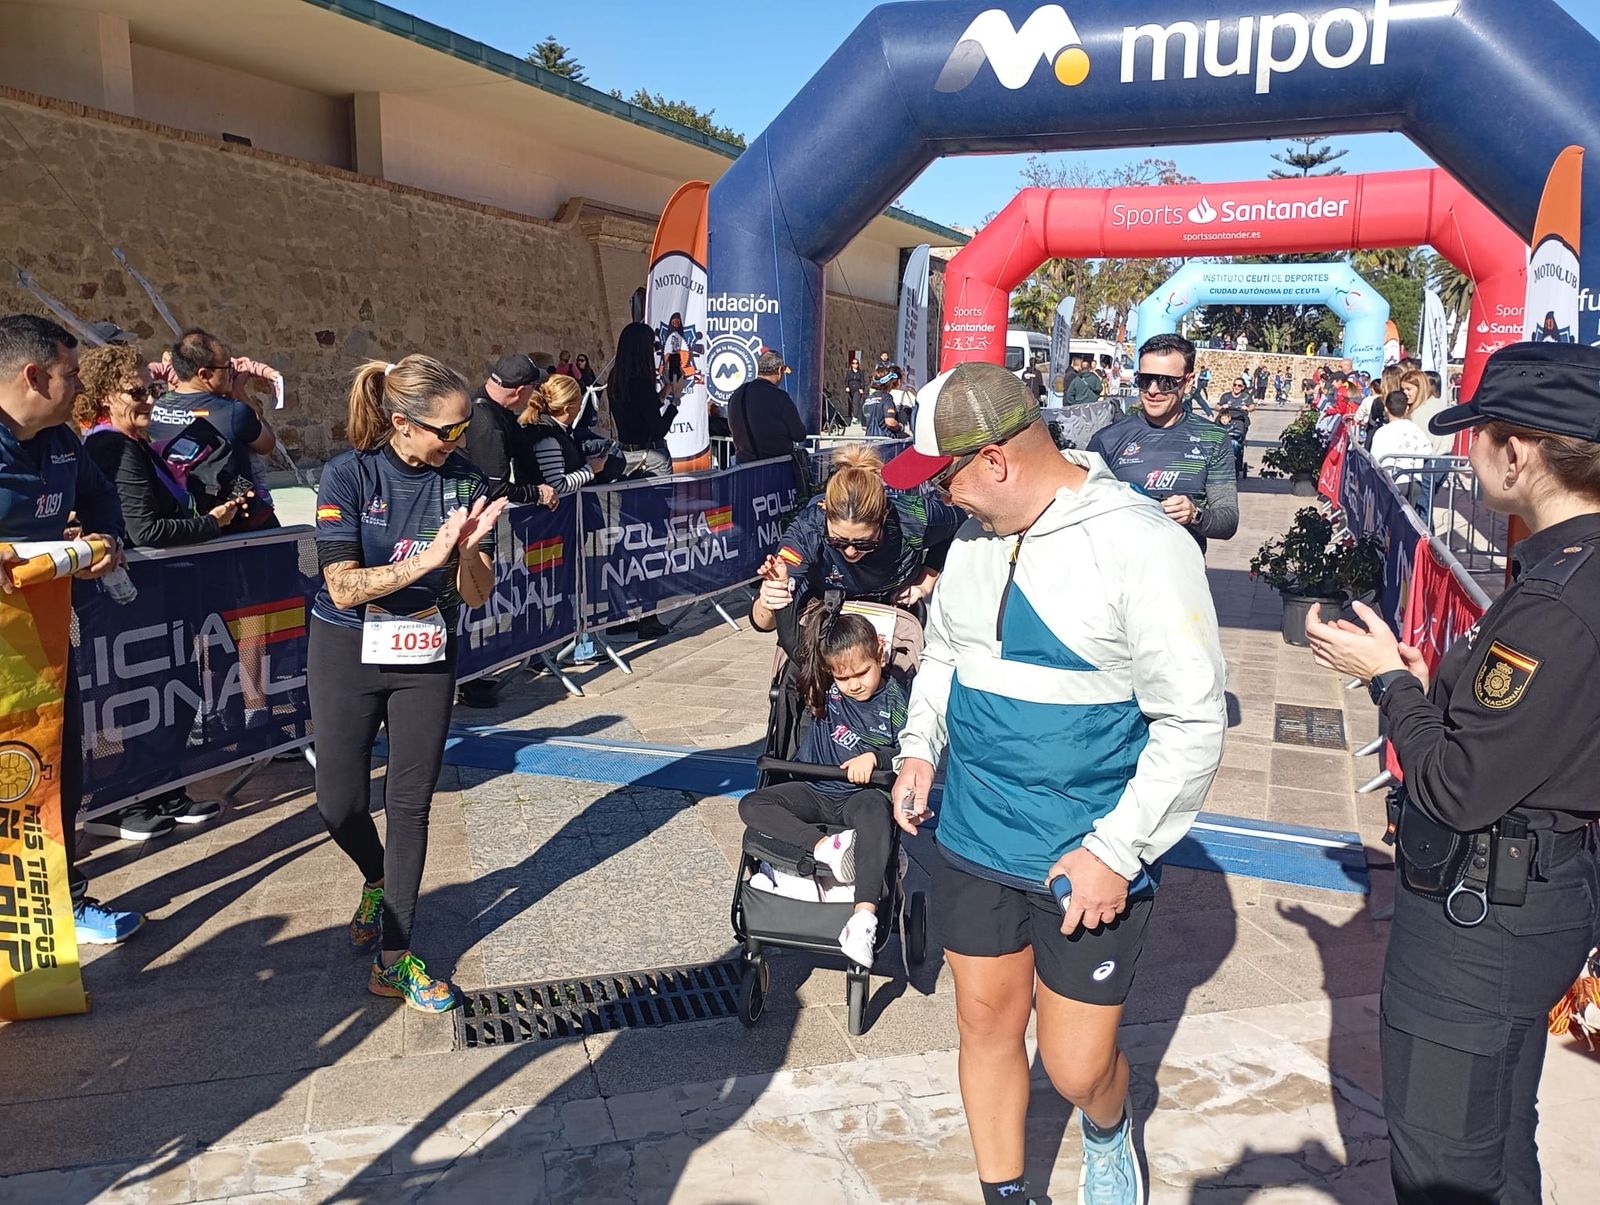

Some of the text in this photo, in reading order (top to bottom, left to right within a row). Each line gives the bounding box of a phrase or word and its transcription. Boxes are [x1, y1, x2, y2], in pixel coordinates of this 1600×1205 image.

[1120, 0, 1391, 94] mupol
[1112, 197, 1349, 230] Sports Santander
[1183, 230, 1261, 242] sportssantander.es
[654, 274, 705, 295] MOTOCLUB
[1203, 274, 1244, 283] INSTITUTO
[1271, 274, 1282, 283] DE
[1285, 273, 1329, 283] DEPORTES
[1534, 263, 1577, 289] MOTOCLUB
[1239, 287, 1281, 295] AUTÓNOMA
[707, 292, 779, 314] ndación
[953, 306, 982, 318] Sports
[1496, 304, 1525, 318] Spor
[706, 313, 758, 335] mupol
[951, 322, 995, 332] Santander
[1490, 323, 1524, 334] Santa
[669, 422, 694, 434] UTA
[1156, 470, 1181, 488] 091
[601, 536, 738, 591] NACIONAL
[391, 632, 442, 650] 1036
[83, 655, 306, 751] IONAL
[1484, 685, 1522, 706] NACIONAL
[838, 729, 861, 749] 091
[24, 804, 58, 969] MIS TIEMPOS
